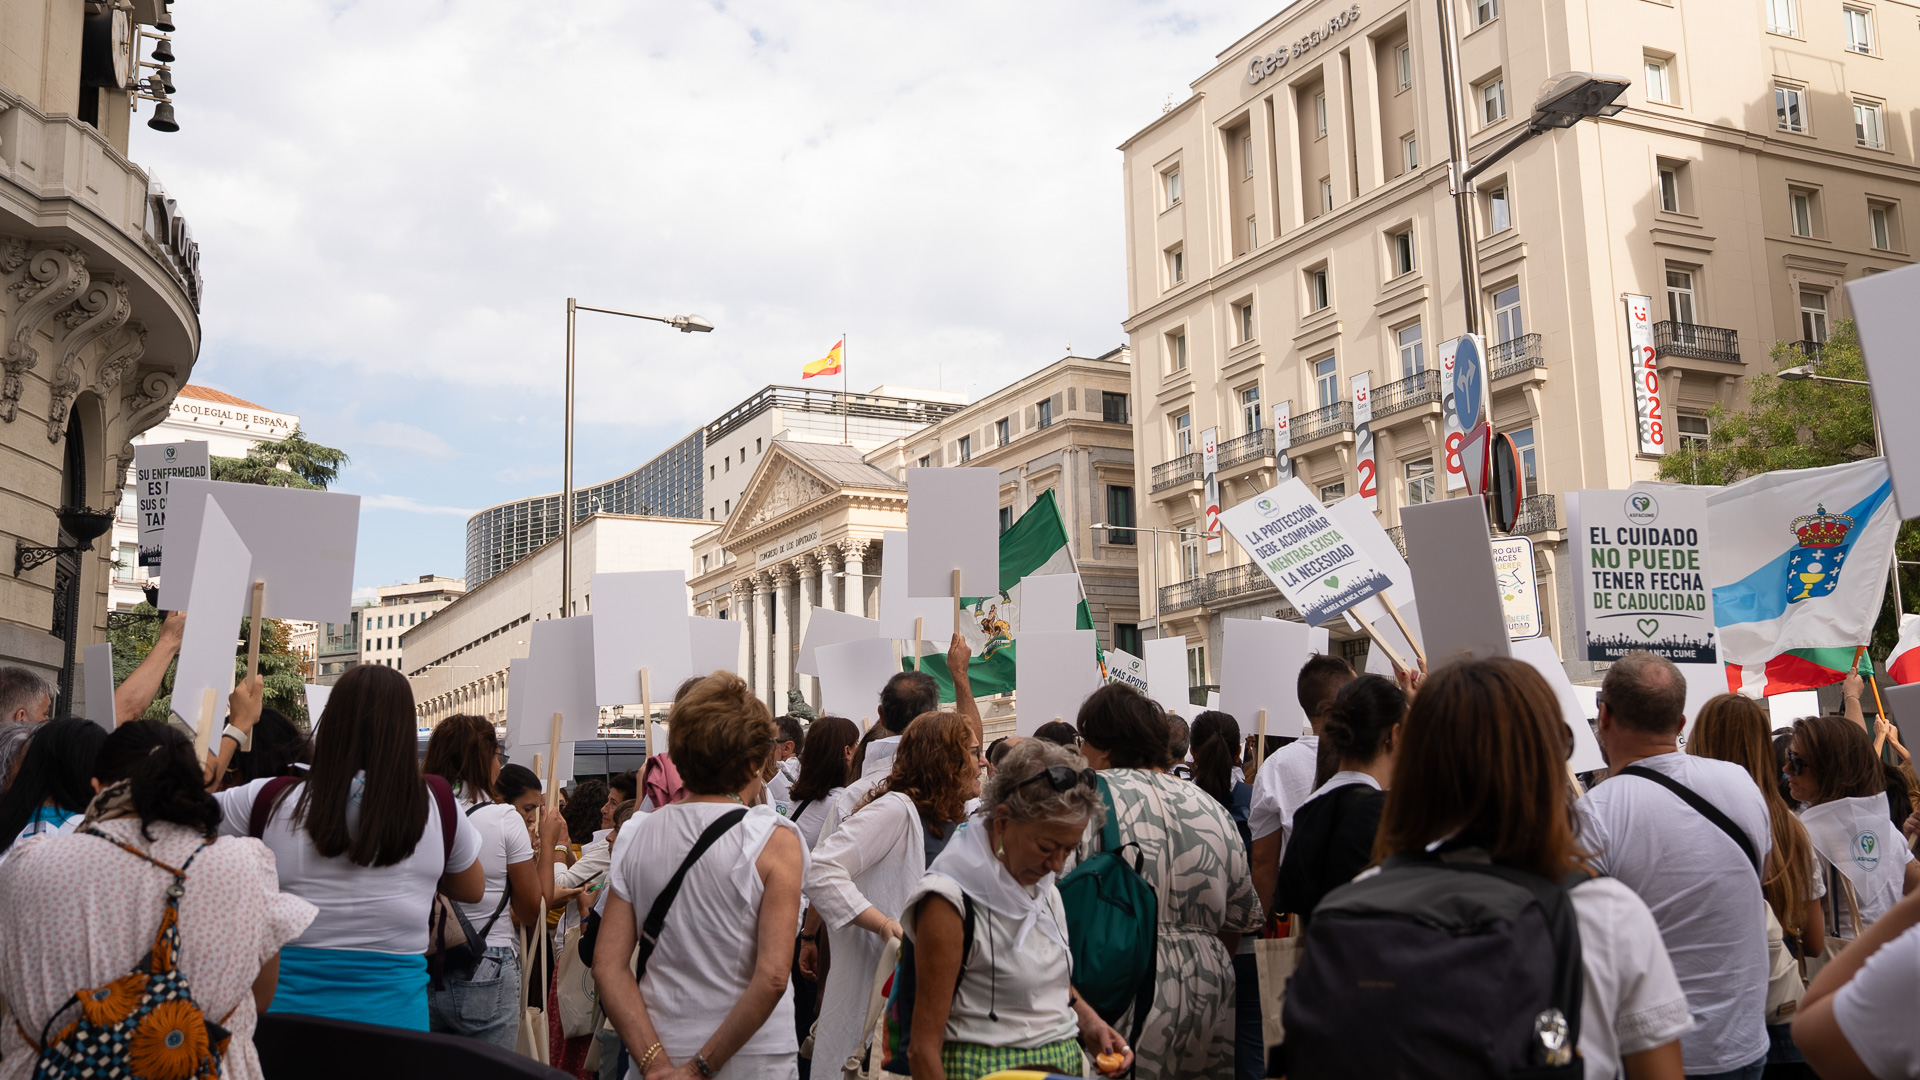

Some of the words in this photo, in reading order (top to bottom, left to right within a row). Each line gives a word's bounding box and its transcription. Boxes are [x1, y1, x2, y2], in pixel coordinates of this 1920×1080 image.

[1247, 45, 1289, 85] Ges
[1291, 3, 1361, 58] SEGUROS
[1643, 346, 1664, 445] 2028
[183, 404, 233, 420] COLEGIAL
[236, 412, 249, 422] DE
[253, 415, 289, 429] ESPAÑA
[138, 469, 150, 480] SU
[152, 465, 206, 479] ENFERMEDAD
[1357, 459, 1377, 499] 2
[148, 481, 162, 495] ES
[140, 499, 157, 510] SUS
[1206, 504, 1221, 541] 2
[1245, 530, 1264, 546] LA
[1260, 503, 1318, 537] PROTECCIÓN
[759, 547, 779, 561] CONGRESO
[780, 544, 785, 554] DE
[796, 531, 818, 548] DIPUTADOS
[1255, 540, 1279, 560] DEBE
[1278, 516, 1331, 551] ACOMPAÑAR
[1590, 527, 1611, 545] EL
[1617, 527, 1698, 546] CUIDADO
[1266, 545, 1315, 574] MIENTRAS
[1311, 529, 1344, 553] EXISTA
[1506, 546, 1522, 554] QUE
[1591, 548, 1621, 569] NO
[1628, 549, 1700, 570] PUEDE
[1281, 571, 1298, 587] LA
[1300, 543, 1355, 580] NECESIDAD
[1496, 562, 1522, 570] UERER
[1592, 571, 1645, 590] TENER
[1651, 572, 1704, 591] FECHA
[1321, 602, 1341, 615] MAREA
[1338, 592, 1360, 606] BLANCA
[1593, 592, 1613, 609] DE
[1618, 592, 1706, 611] CADUCIDAD
[1605, 648, 1632, 657] MARE
[1673, 650, 1697, 658] CUME
[1111, 667, 1127, 680] MÁS
[1126, 675, 1148, 692] APOYO,
